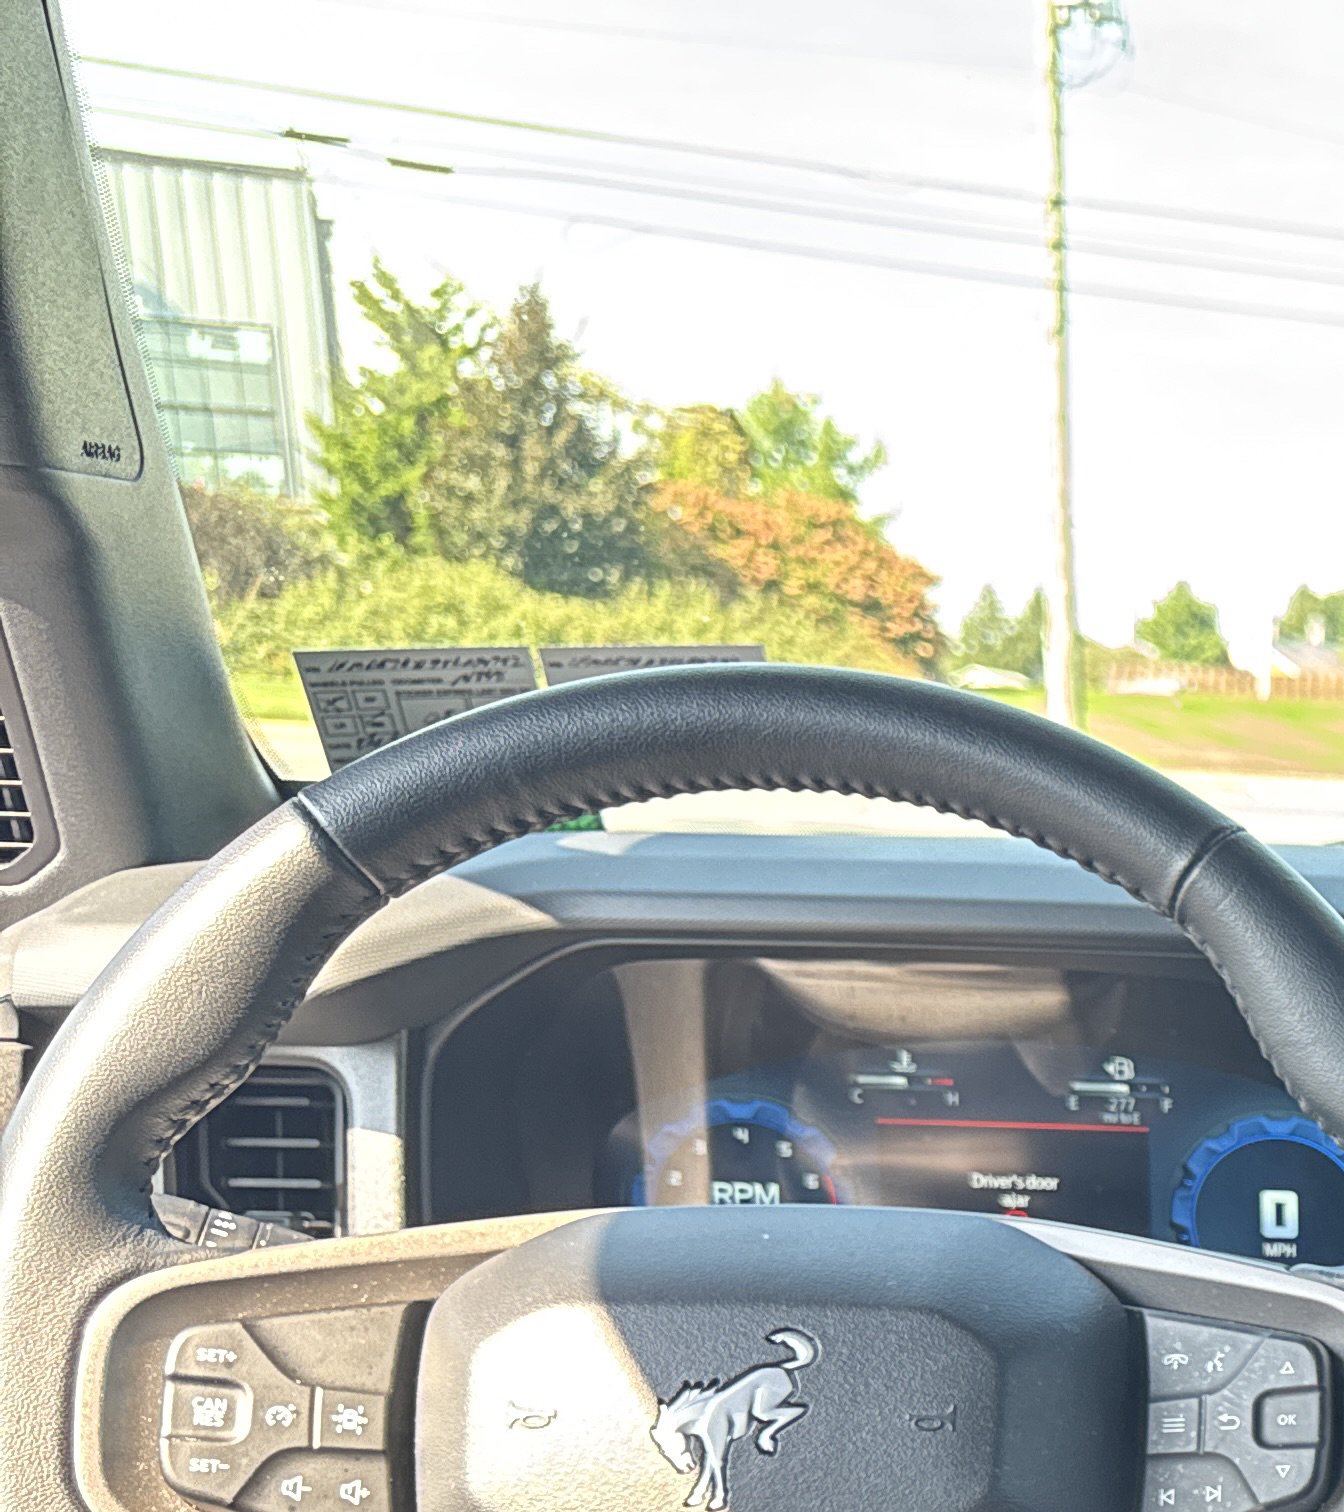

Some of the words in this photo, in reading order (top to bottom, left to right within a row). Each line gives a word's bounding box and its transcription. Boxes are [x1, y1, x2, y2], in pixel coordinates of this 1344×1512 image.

[1107, 1097, 1135, 1112] 277
[969, 1171, 1026, 1190] Driver's
[1026, 1174, 1060, 1191] door
[711, 1181, 781, 1204] RPM
[998, 1192, 1031, 1209] ajar
[1259, 1189, 1299, 1239] 0
[1262, 1242, 1297, 1258] MPH
[192, 1396, 228, 1411] CAN
[1277, 1414, 1297, 1426] OK
